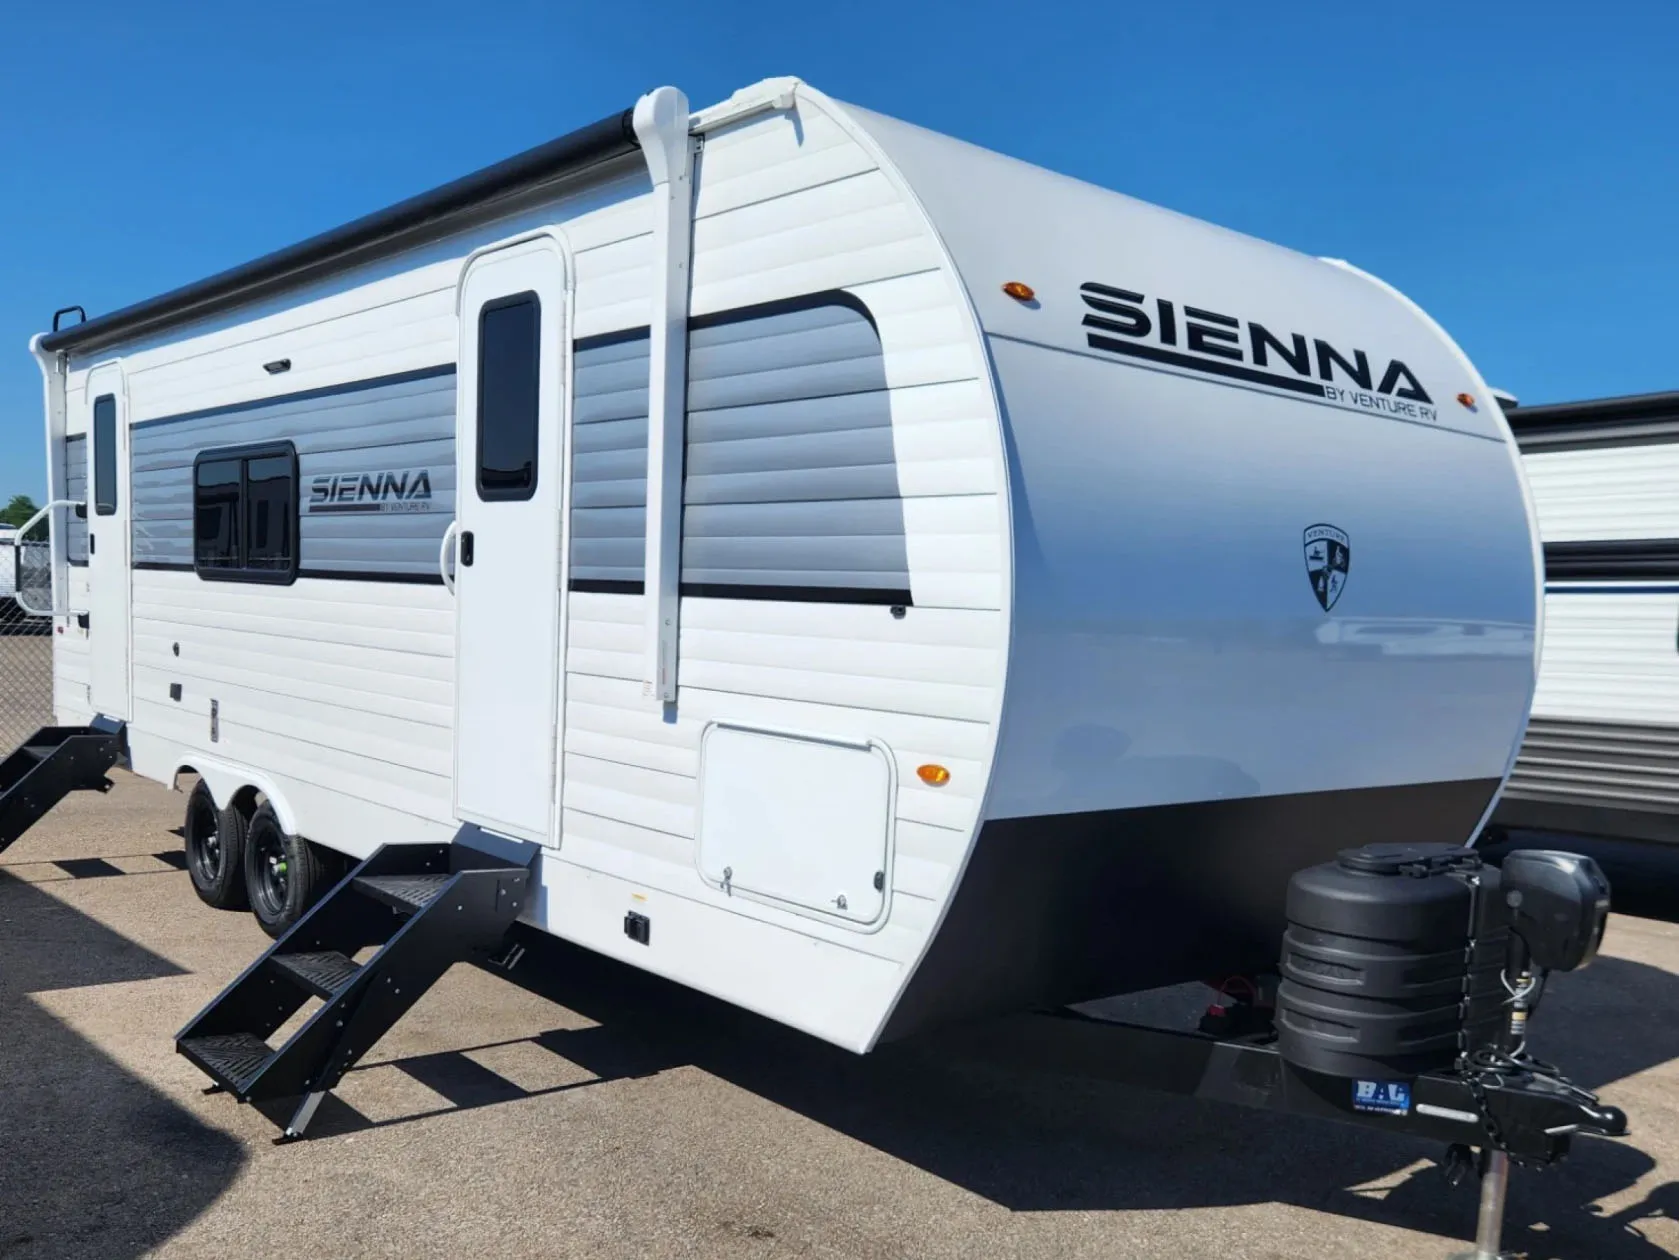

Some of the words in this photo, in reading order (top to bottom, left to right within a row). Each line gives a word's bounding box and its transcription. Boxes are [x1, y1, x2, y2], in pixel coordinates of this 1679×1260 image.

[1080, 281, 1434, 404] SIENNA
[1325, 386, 1345, 402] BY
[1349, 391, 1417, 418] VENTURE
[1419, 406, 1437, 421] RV
[309, 469, 432, 502] SIENNA
